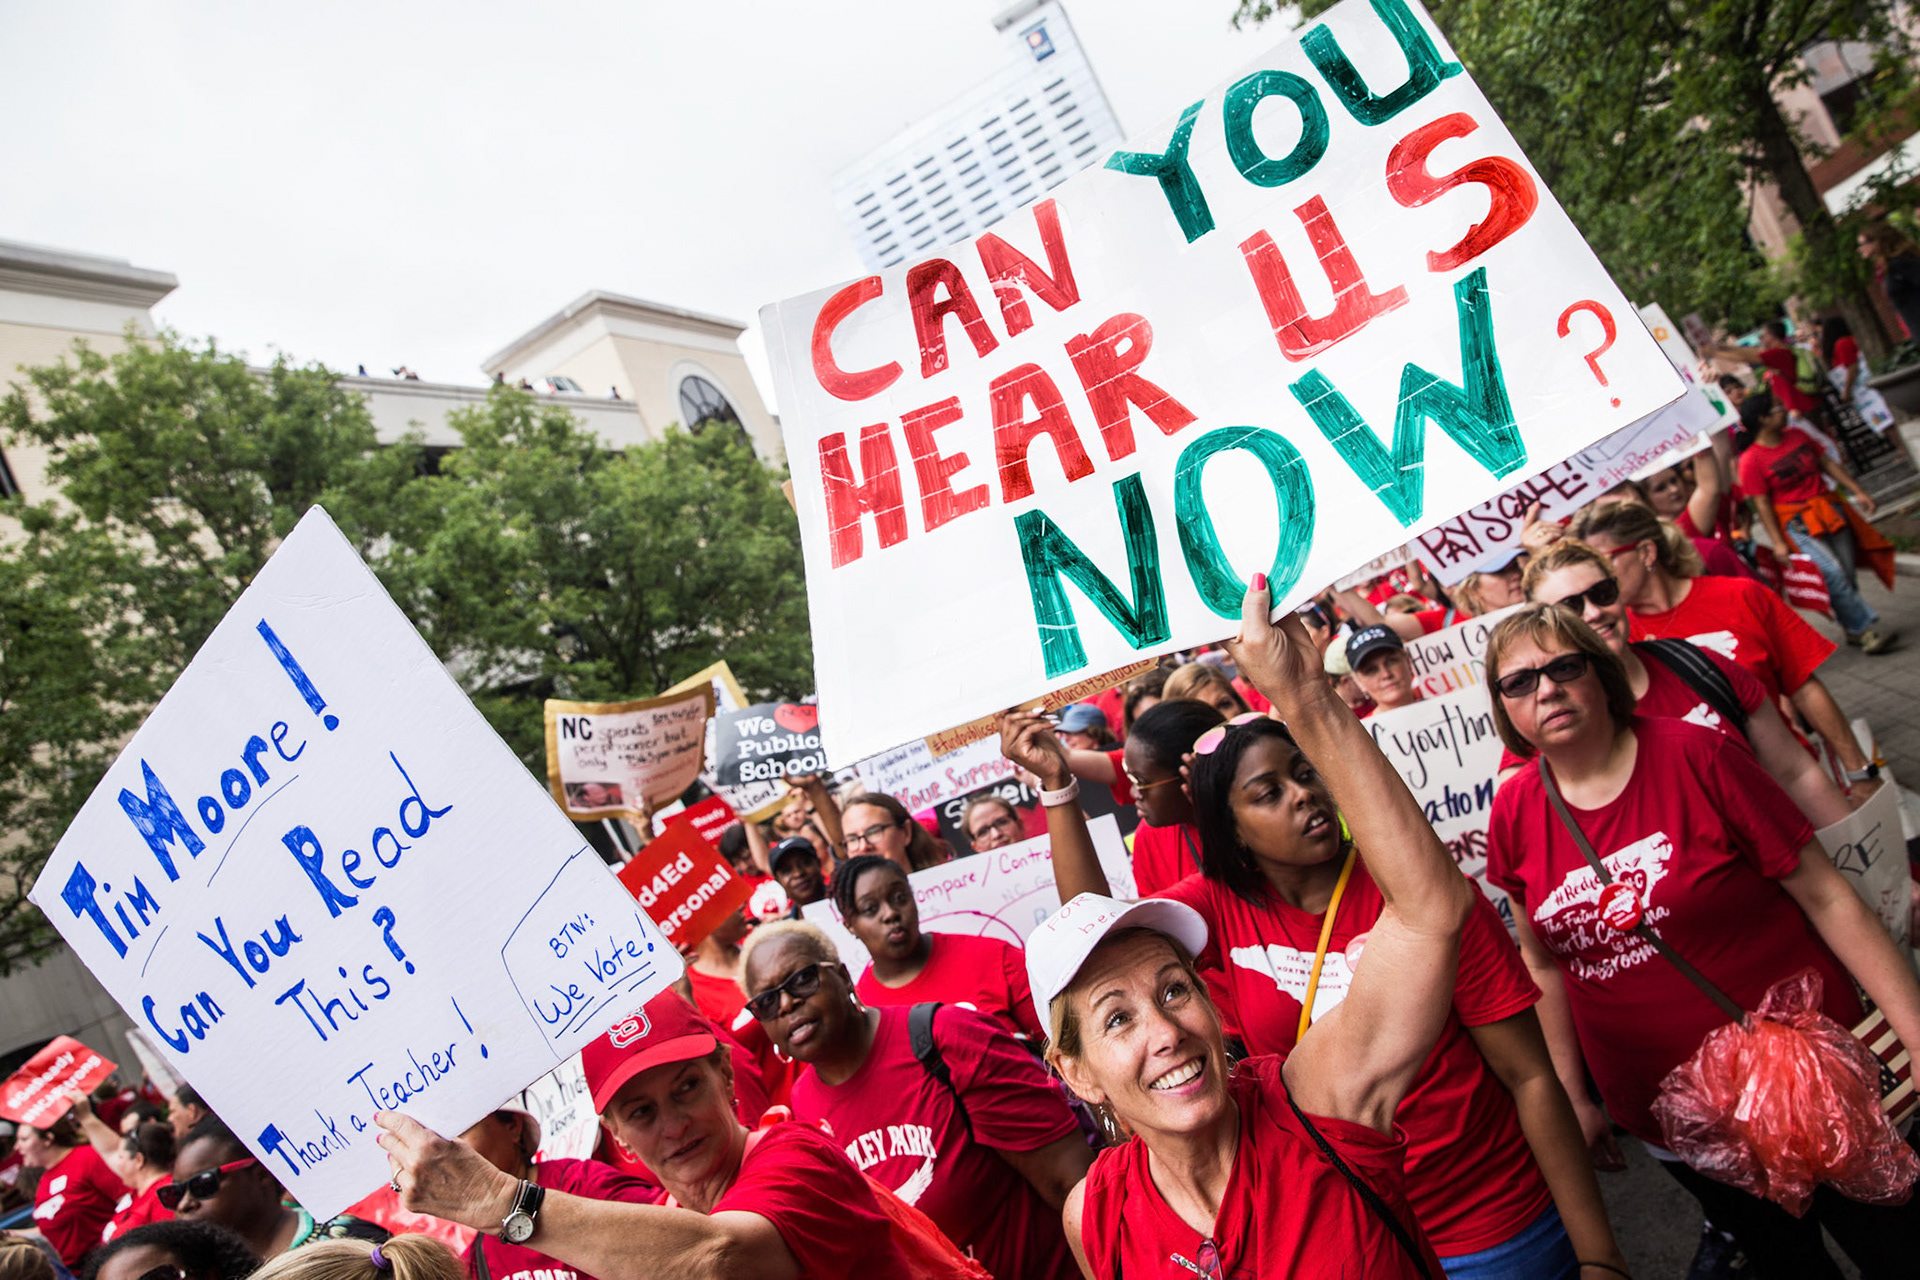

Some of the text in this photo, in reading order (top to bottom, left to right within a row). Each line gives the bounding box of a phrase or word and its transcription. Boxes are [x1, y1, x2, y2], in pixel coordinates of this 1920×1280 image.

[811, 0, 1463, 402] CAN YOU
[818, 112, 1539, 569] HEAR US
[1012, 266, 1529, 681] NOW
[1417, 515, 1484, 569] PAY
[117, 618, 341, 882] Moore!
[562, 717, 593, 741] NC
[734, 715, 776, 737] We
[737, 733, 819, 759] Public
[739, 751, 828, 782] School
[142, 750, 454, 1054] Can You Read
[274, 905, 416, 1042] This?
[533, 910, 655, 1024] We Vote!
[257, 996, 489, 1176] Thank a Teacher!
[844, 1123, 938, 1172] LEY PARK
